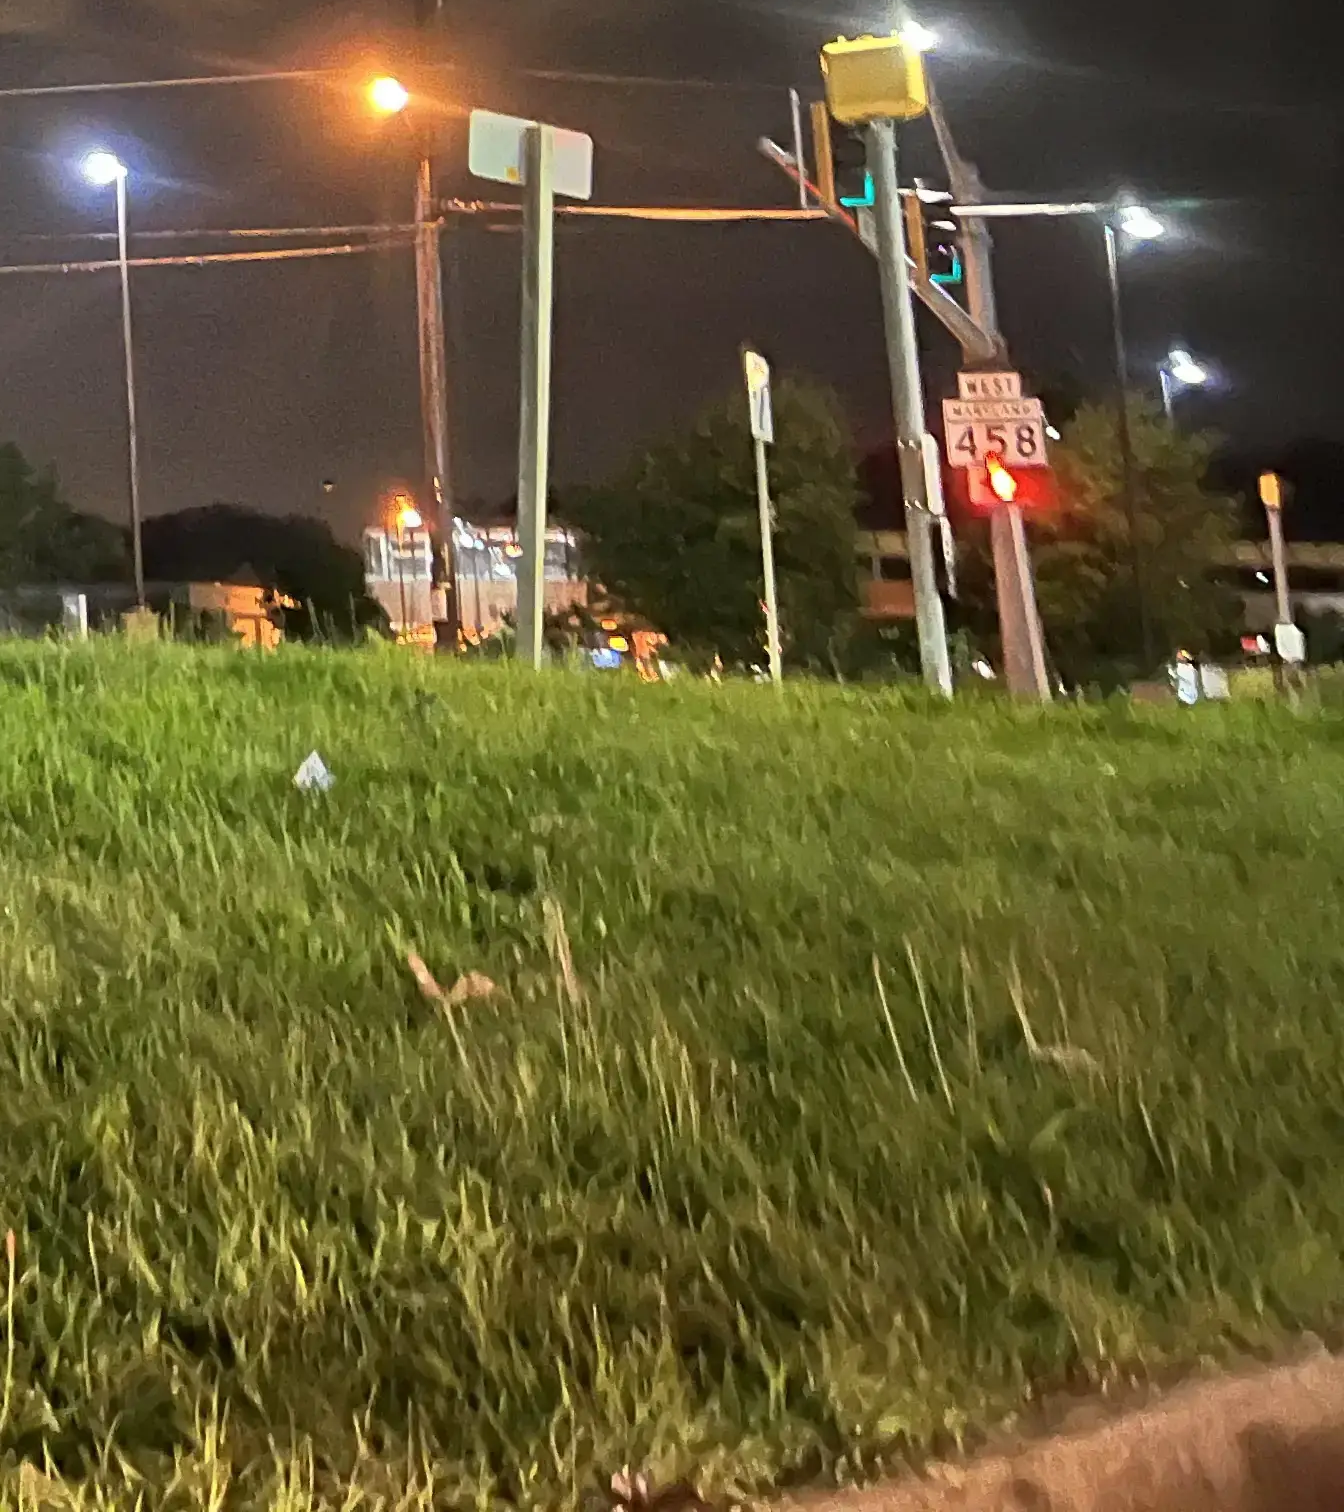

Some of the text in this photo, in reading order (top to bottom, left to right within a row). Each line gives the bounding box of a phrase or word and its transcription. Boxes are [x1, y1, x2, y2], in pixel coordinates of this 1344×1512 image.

[964, 378, 1014, 396] WEST
[952, 403, 1031, 417] MARYLAND
[955, 423, 1037, 460] 458
